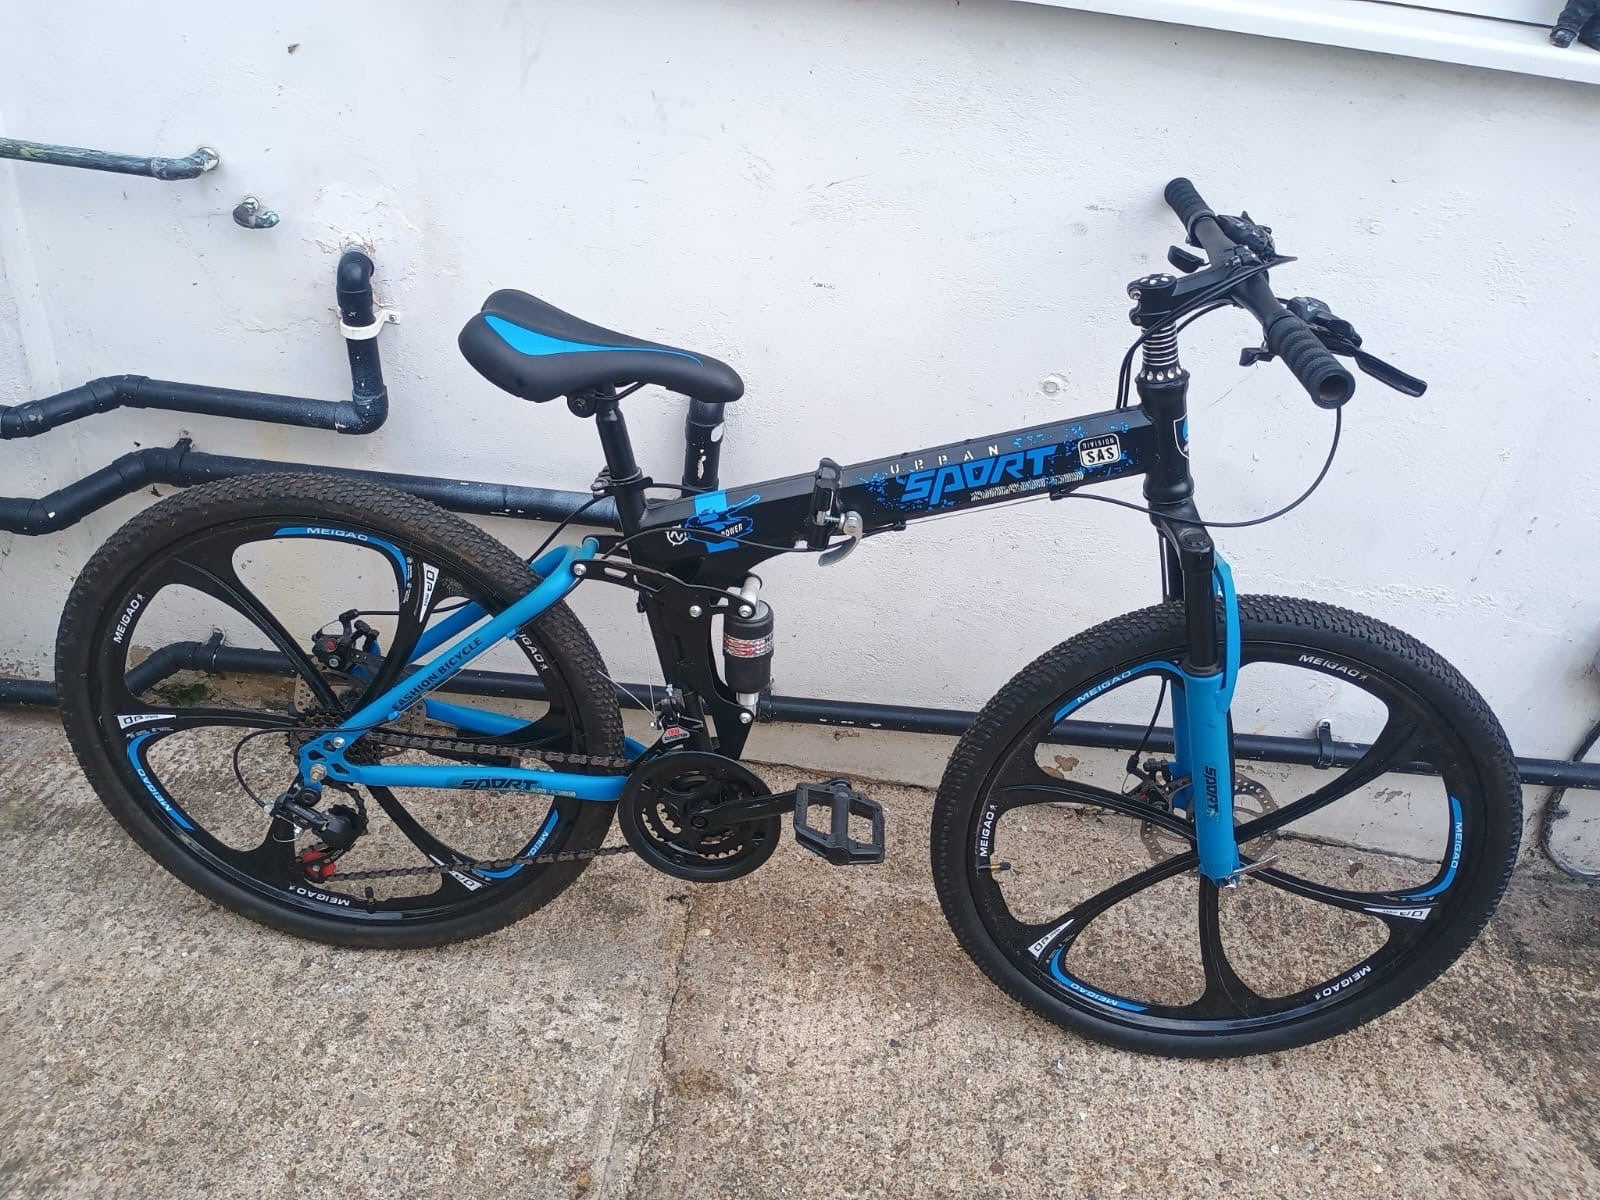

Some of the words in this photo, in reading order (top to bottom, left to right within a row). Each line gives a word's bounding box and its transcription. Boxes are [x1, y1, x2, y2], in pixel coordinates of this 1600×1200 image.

[1082, 437, 1115, 449] DIVISION
[1086, 447, 1115, 463] SAS
[890, 445, 998, 474] URBAN
[901, 443, 1058, 505] SPORT
[306, 527, 368, 541] MEIGAO
[720, 523, 743, 537] POWER
[113, 600, 140, 644] MEIGAO
[519, 631, 545, 662] IGAO
[391, 672, 442, 711] FASHION
[439, 637, 482, 680] BICYCLE
[1299, 654, 1360, 677] MEIGAO
[1077, 670, 1131, 703] MEIGAO
[138, 768, 173, 811] MEIGAO
[460, 778, 538, 790] SPORT
[528, 831, 548, 857] MEIG
[980, 811, 995, 857] MEIGAO
[1451, 822, 1463, 869] MEIGAO
[297, 887, 350, 906] MEIGAO
[1070, 983, 1118, 1007] MEIGAO
[1322, 965, 1372, 998] MEIGAO
